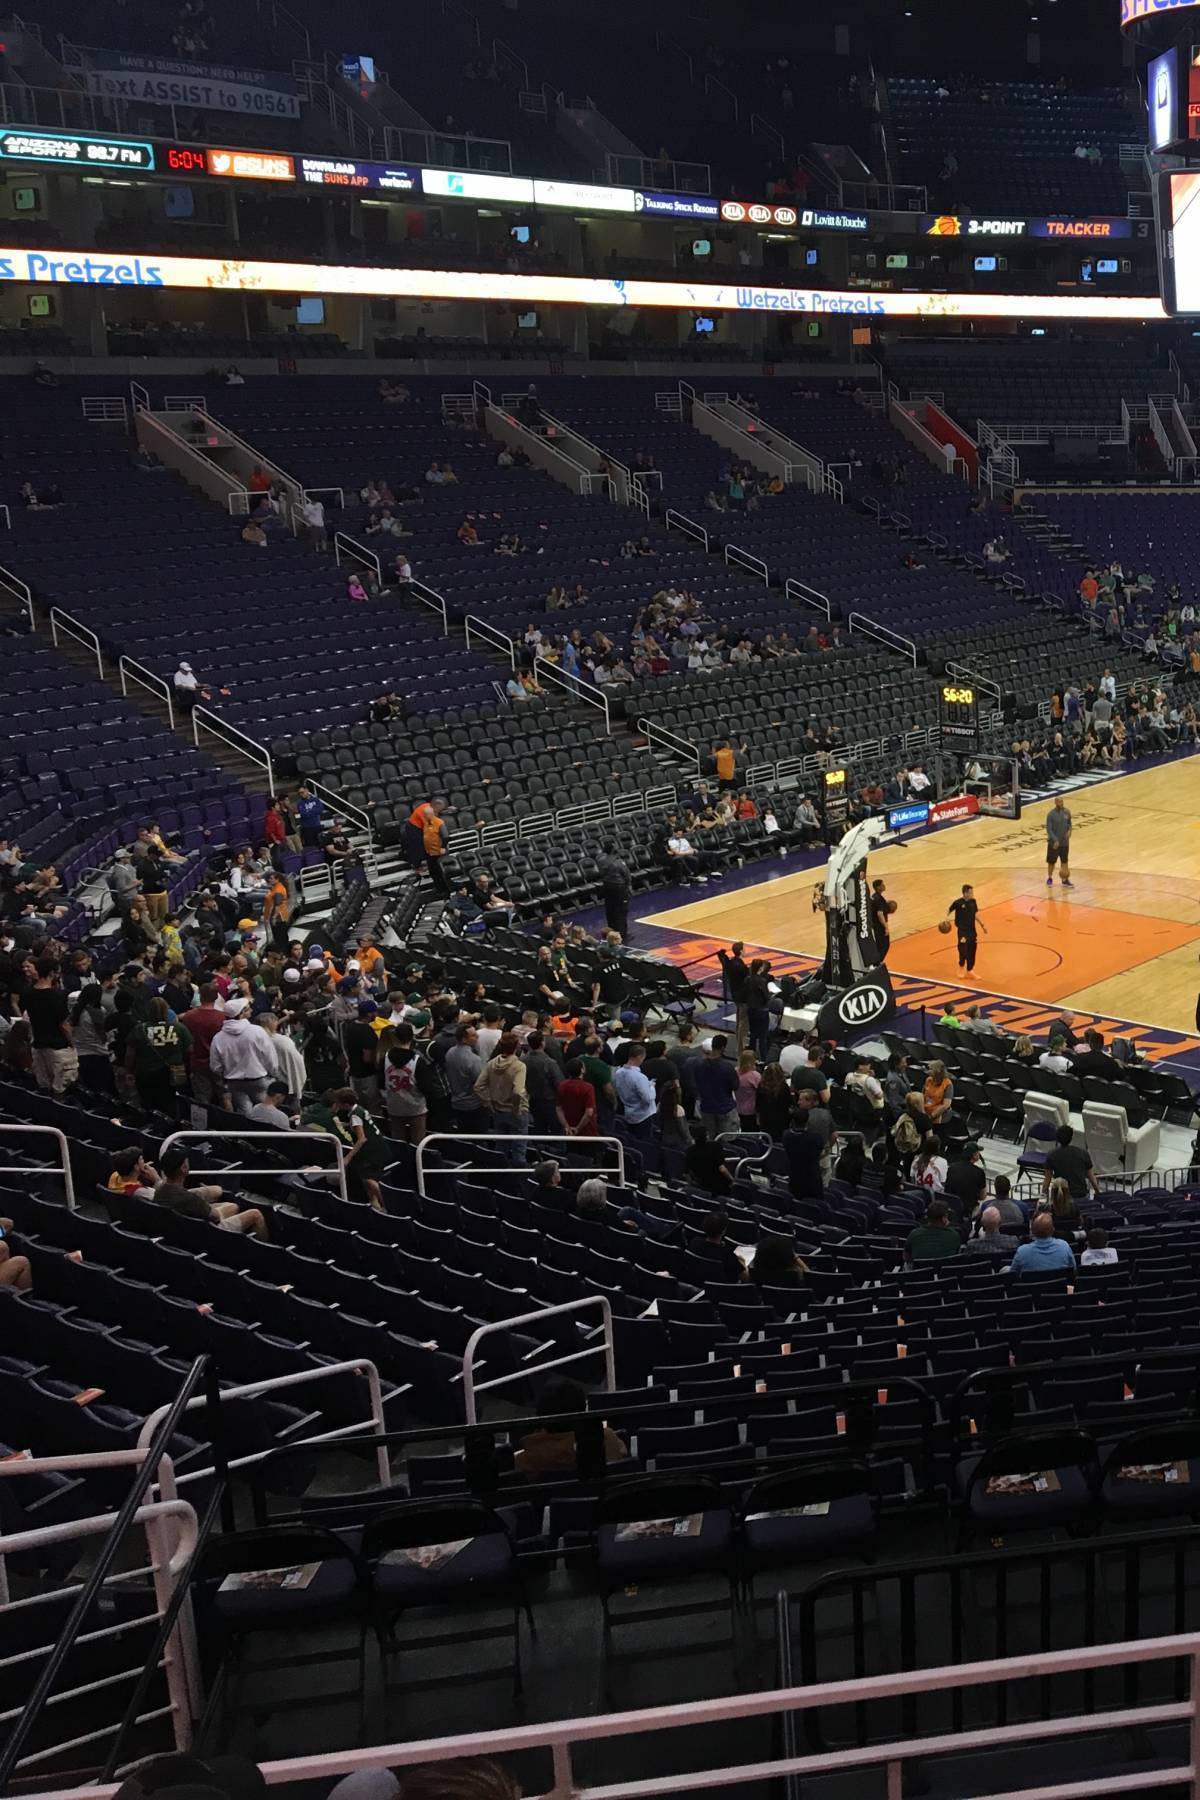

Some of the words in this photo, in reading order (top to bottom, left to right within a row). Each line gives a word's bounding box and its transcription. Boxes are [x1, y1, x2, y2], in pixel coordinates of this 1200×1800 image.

[120, 55, 145, 68] HAVE
[147, 59, 154, 69] A
[156, 60, 208, 77] QUESTION?
[91, 73, 138, 96] Text
[143, 80, 212, 105] ASSIST
[218, 88, 237, 107] to
[243, 92, 297, 114] 90561
[4, 137, 80, 151] ARIZONA
[8, 145, 77, 158] SPORTS
[121, 149, 142, 163] FM
[169, 149, 204, 169] 6:04
[302, 159, 356, 175] DOWNLOAD
[304, 171, 324, 183] THE
[324, 173, 349, 185] SUNS
[349, 176, 369, 187] APP
[379, 176, 414, 189] verizon
[725, 206, 742, 217] KIA
[752, 208, 769, 220] KIA
[777, 211, 794, 222] KIA
[814, 213, 835, 226] Lovitt
[968, 220, 1025, 235] 3-POINT
[1047, 221, 1111, 236] TRACKER
[27, 253, 164, 286] Pretzels
[736, 287, 806, 310] Wetzel's
[811, 292, 886, 315] Pretzels
[943, 686, 973, 704] 56:20
[951, 727, 976, 736] TISSOT
[858, 878, 869, 939] Southwest
[845, 990, 881, 1020] KIA
[153, 1025, 178, 1046] 34
